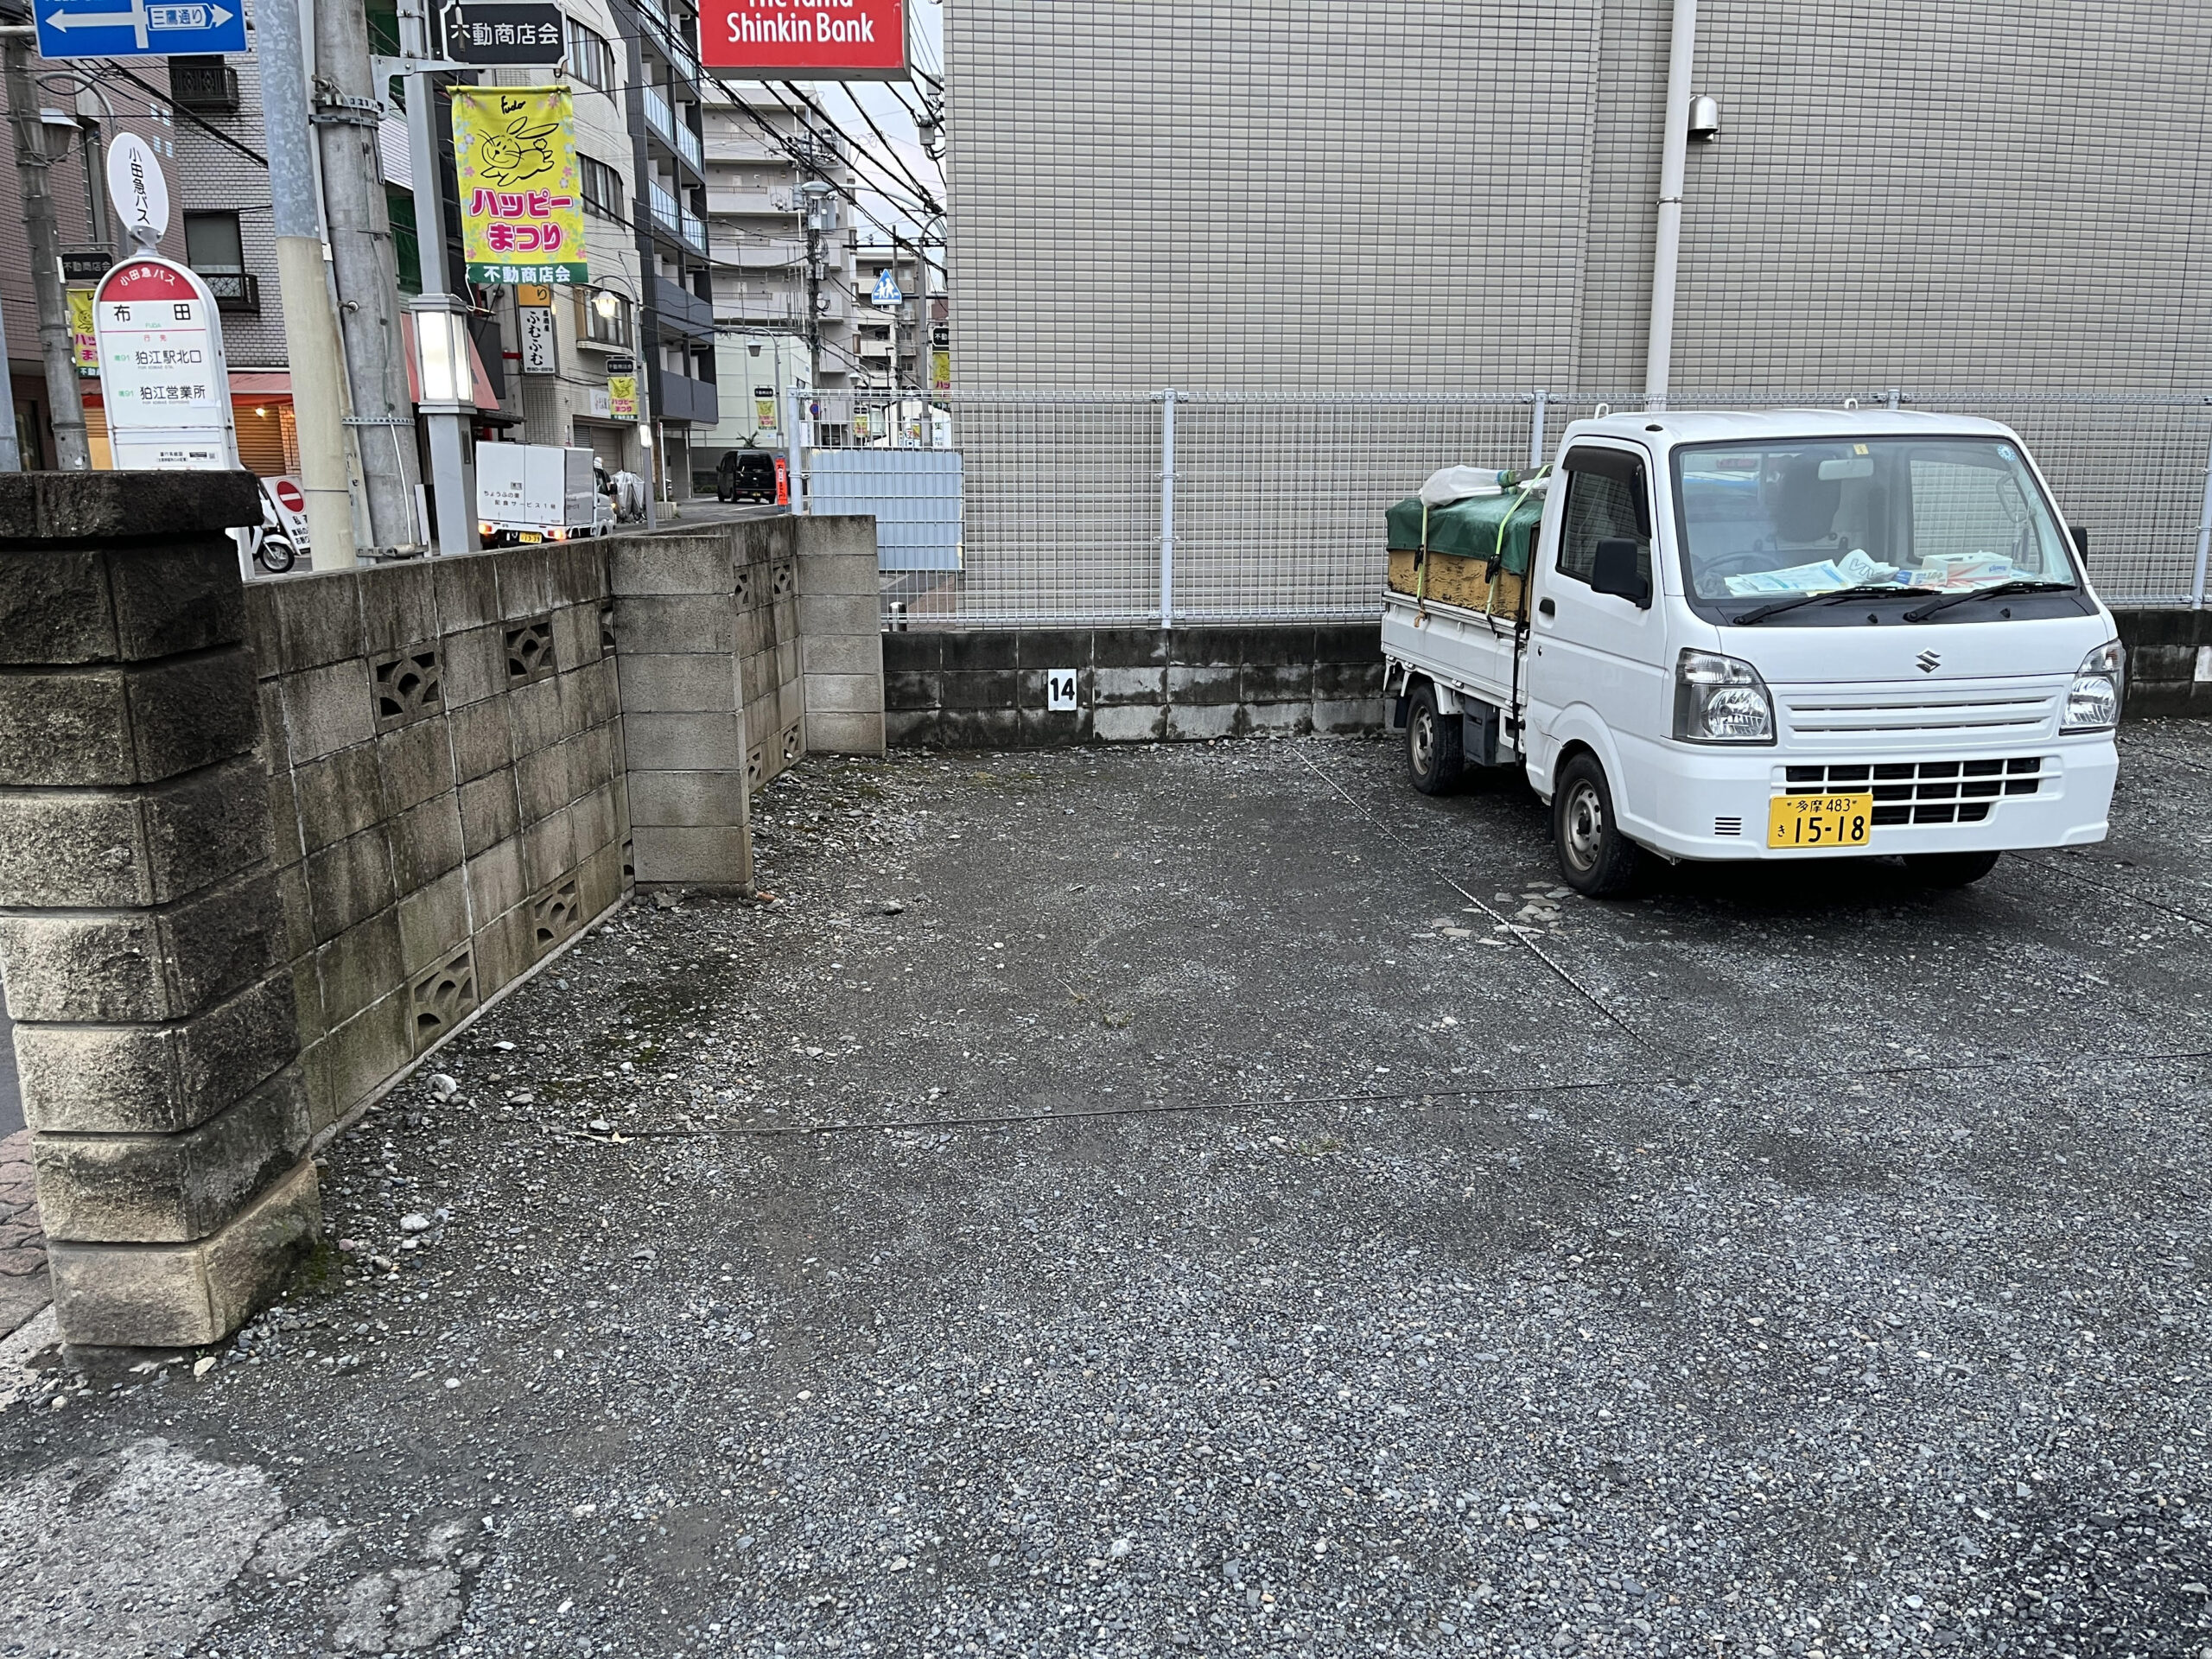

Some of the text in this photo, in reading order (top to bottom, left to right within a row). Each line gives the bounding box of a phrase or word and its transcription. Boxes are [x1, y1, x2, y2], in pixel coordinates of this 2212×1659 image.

[727, 12, 874, 43] Shinkin Bank
[129, 146, 150, 225] 小田急バス
[470, 187, 574, 219] ハッピー
[486, 221, 563, 253] まつり
[119, 267, 176, 287] 小田急バス
[483, 264, 570, 283] 不動商店会
[526, 310, 543, 365] ふむふむ
[136, 349, 202, 365] 狛江駅北口
[1050, 677, 1076, 702] 14
[1796, 798, 1851, 813] 多摩 483
[1777, 816, 1865, 842] き 15-18
